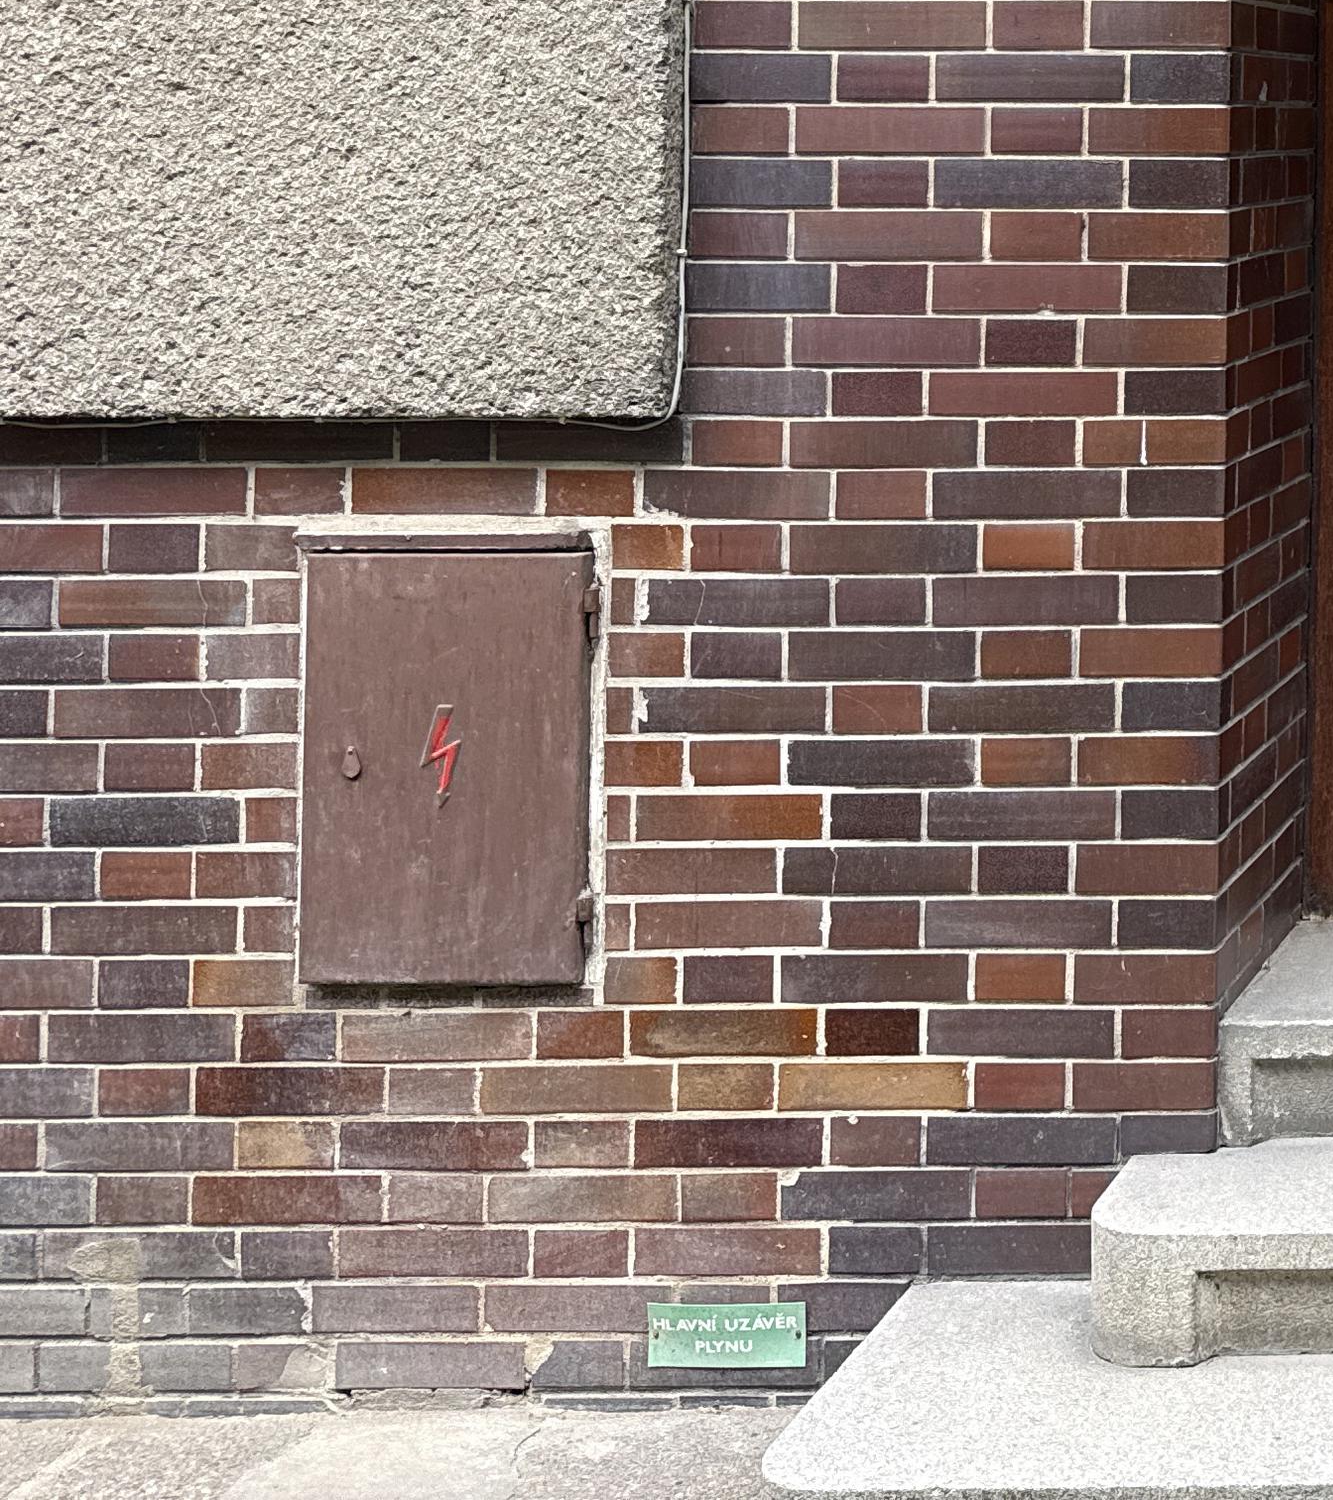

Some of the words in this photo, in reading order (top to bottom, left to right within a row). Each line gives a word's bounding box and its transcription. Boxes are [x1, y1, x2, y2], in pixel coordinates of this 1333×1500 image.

[652, 1314, 718, 1332] HLAVNÍ
[724, 1312, 798, 1332] UZÁVĚR
[694, 1339, 754, 1354] PLYNU
